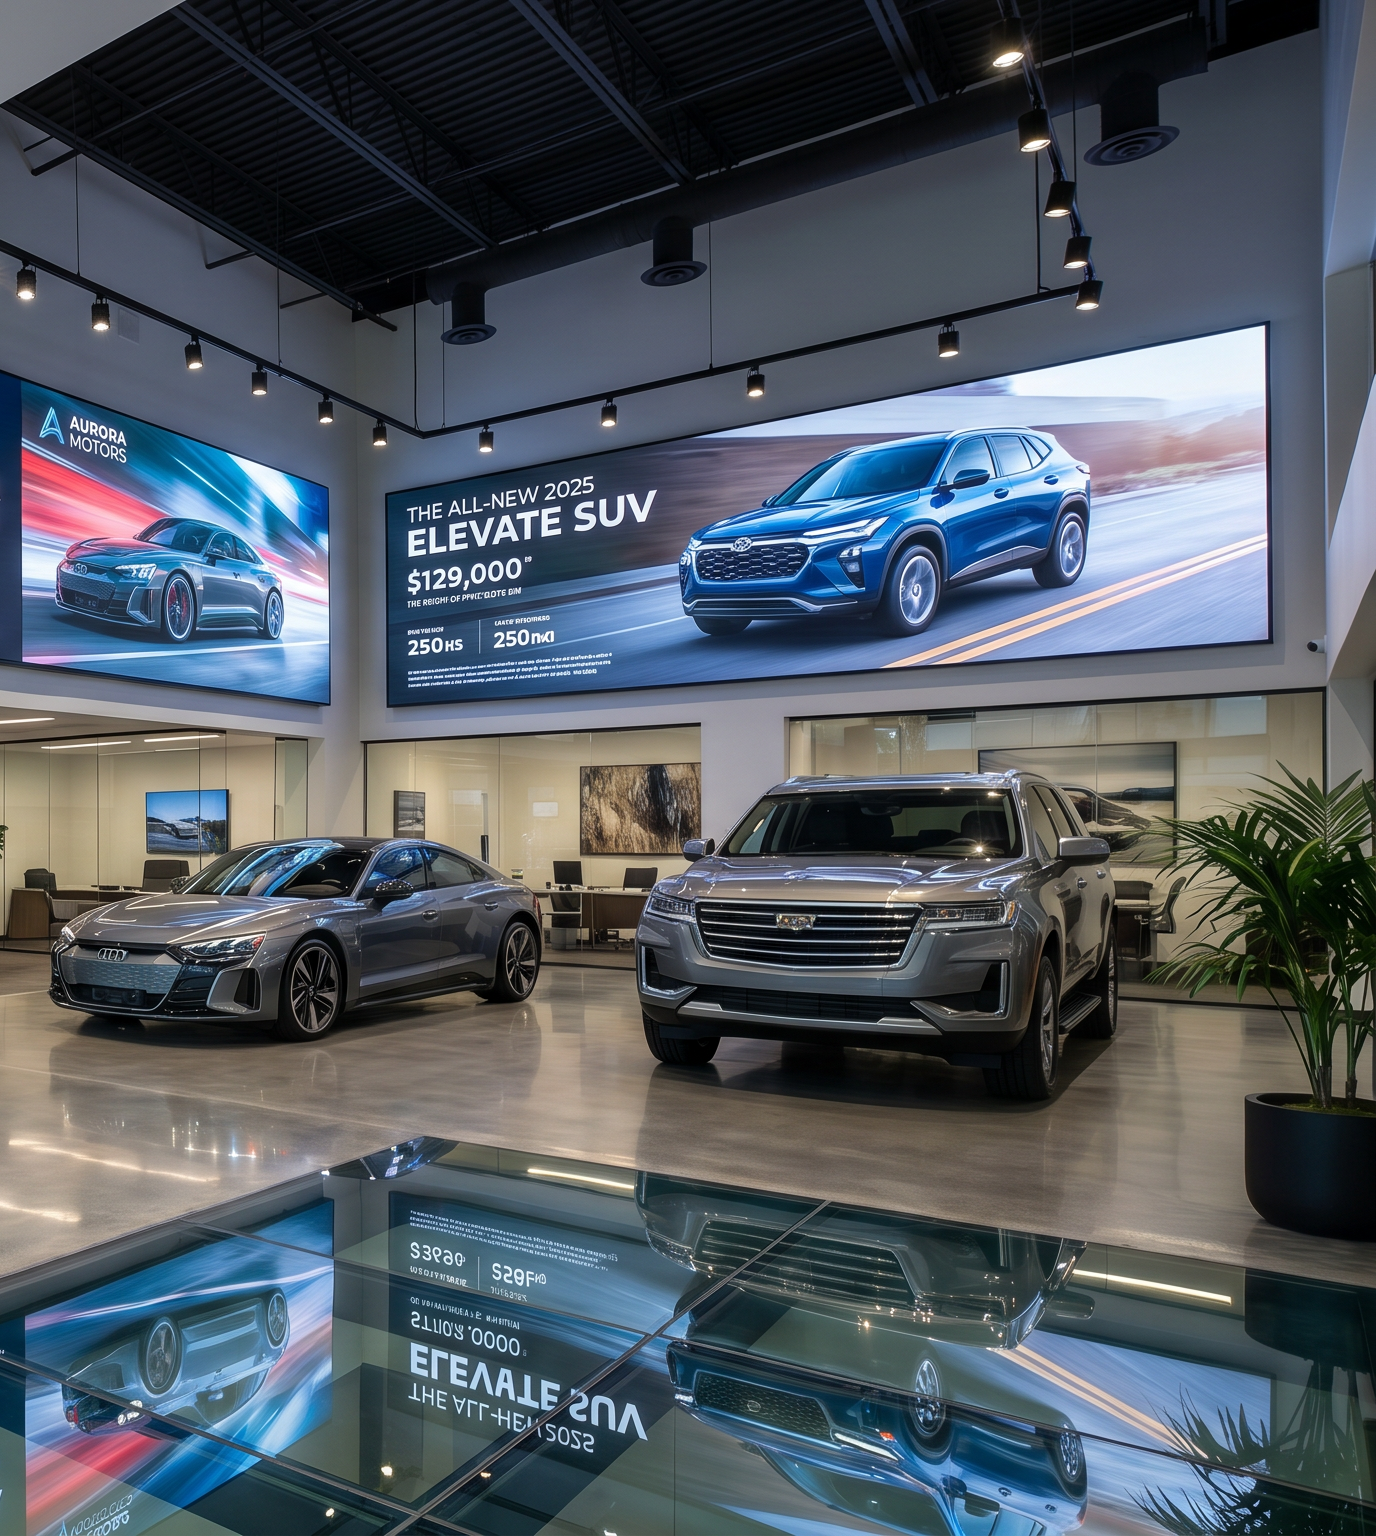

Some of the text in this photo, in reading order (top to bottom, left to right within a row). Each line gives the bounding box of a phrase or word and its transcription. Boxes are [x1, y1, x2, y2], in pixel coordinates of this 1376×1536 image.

[69, 415, 127, 447] AURORA
[69, 432, 127, 464] MOTORS
[406, 475, 595, 524] THE ALL-NEW 2025
[407, 489, 658, 558] ELEVATE SUV
